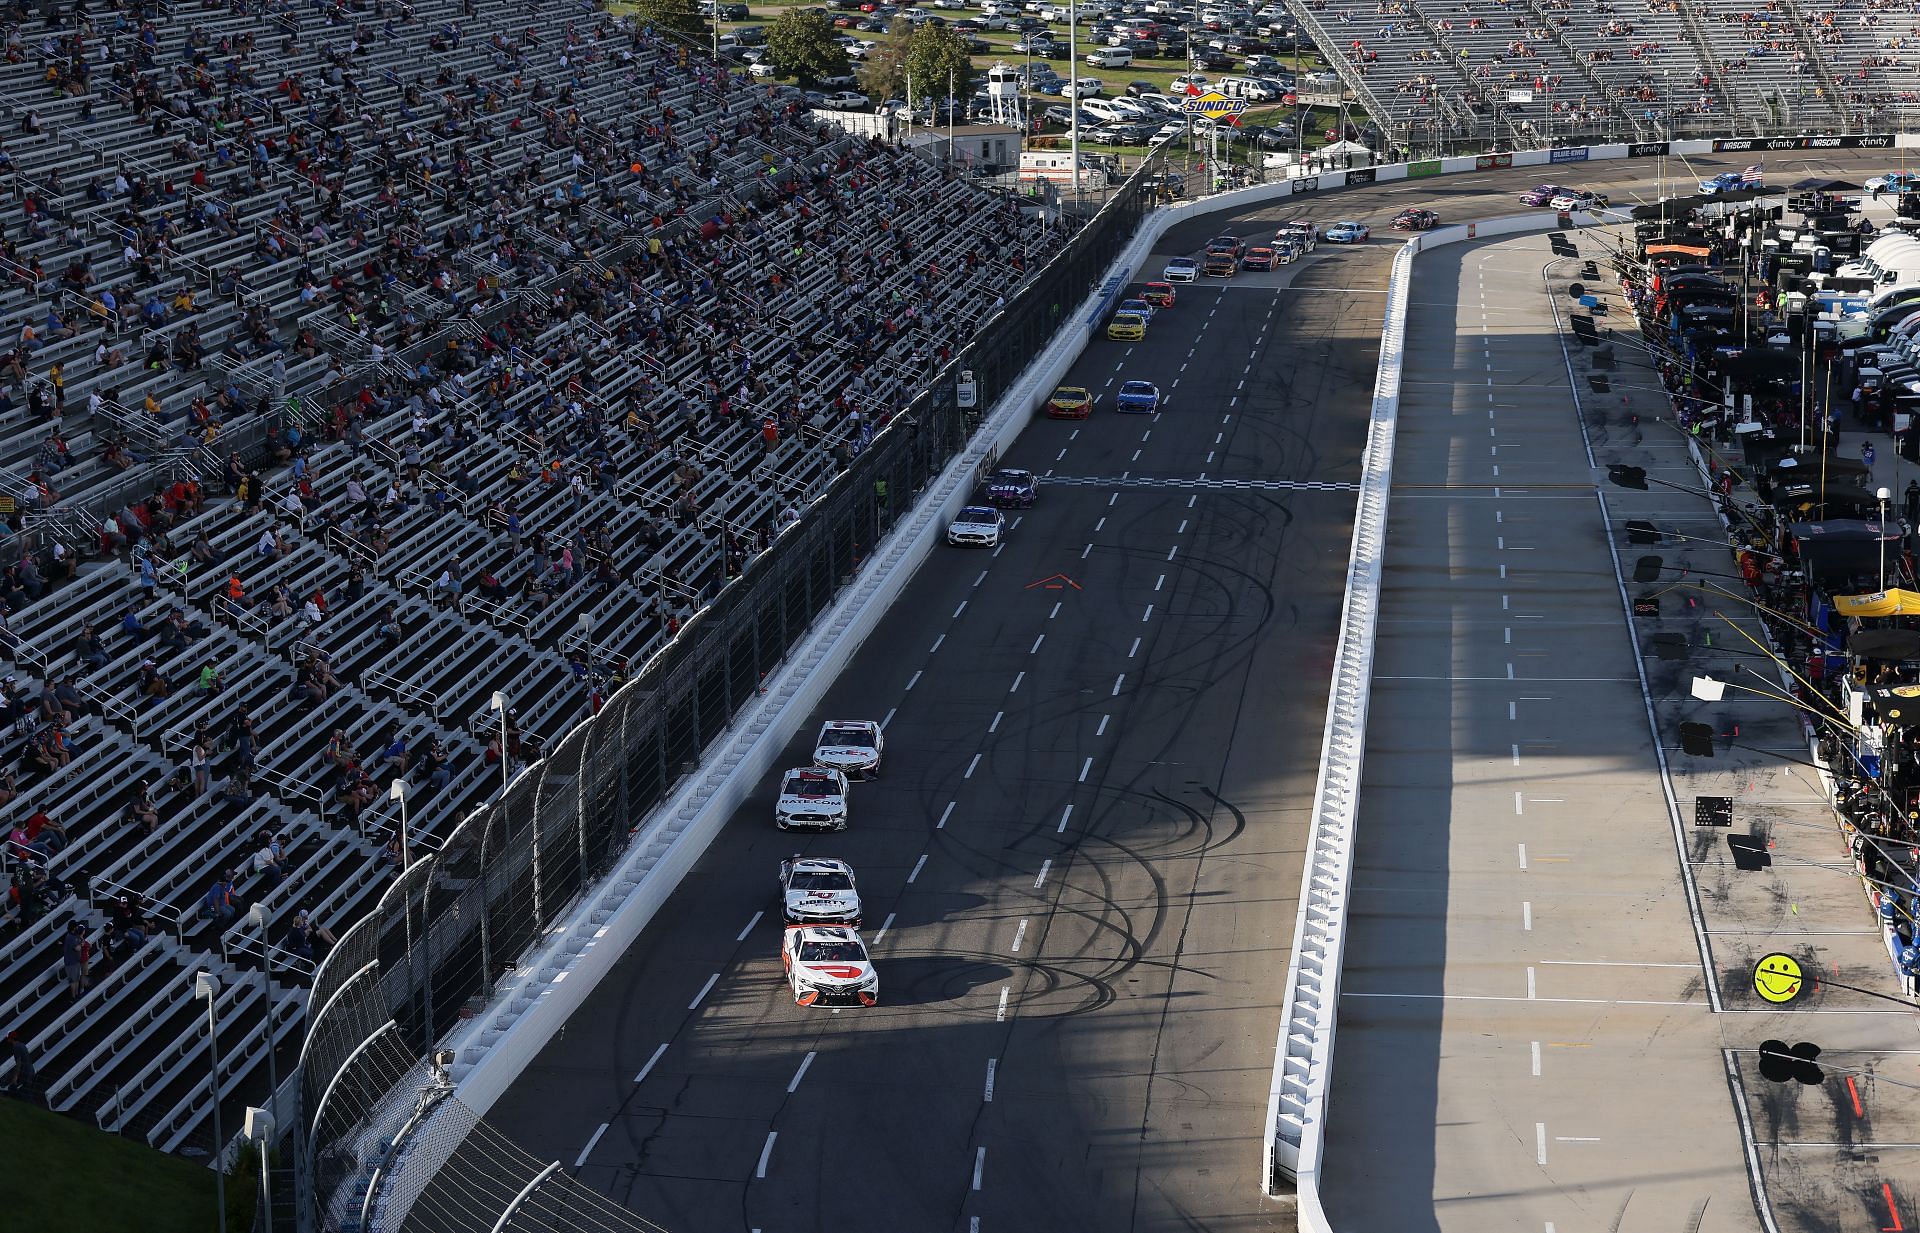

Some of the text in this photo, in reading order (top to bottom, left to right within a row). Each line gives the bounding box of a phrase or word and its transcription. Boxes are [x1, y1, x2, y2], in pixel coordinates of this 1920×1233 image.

[1187, 101, 1243, 111] SUNOCO
[1723, 141, 1752, 149] NASCAR
[1767, 139, 1796, 150] xfinity
[1811, 138, 1842, 147] NASCAR
[1858, 137, 1888, 148] xfinity
[1553, 149, 1586, 158] BLUE-EMU
[1635, 144, 1663, 156] xfinity
[990, 485, 1028, 494] ally
[821, 749, 869, 757] FedEx
